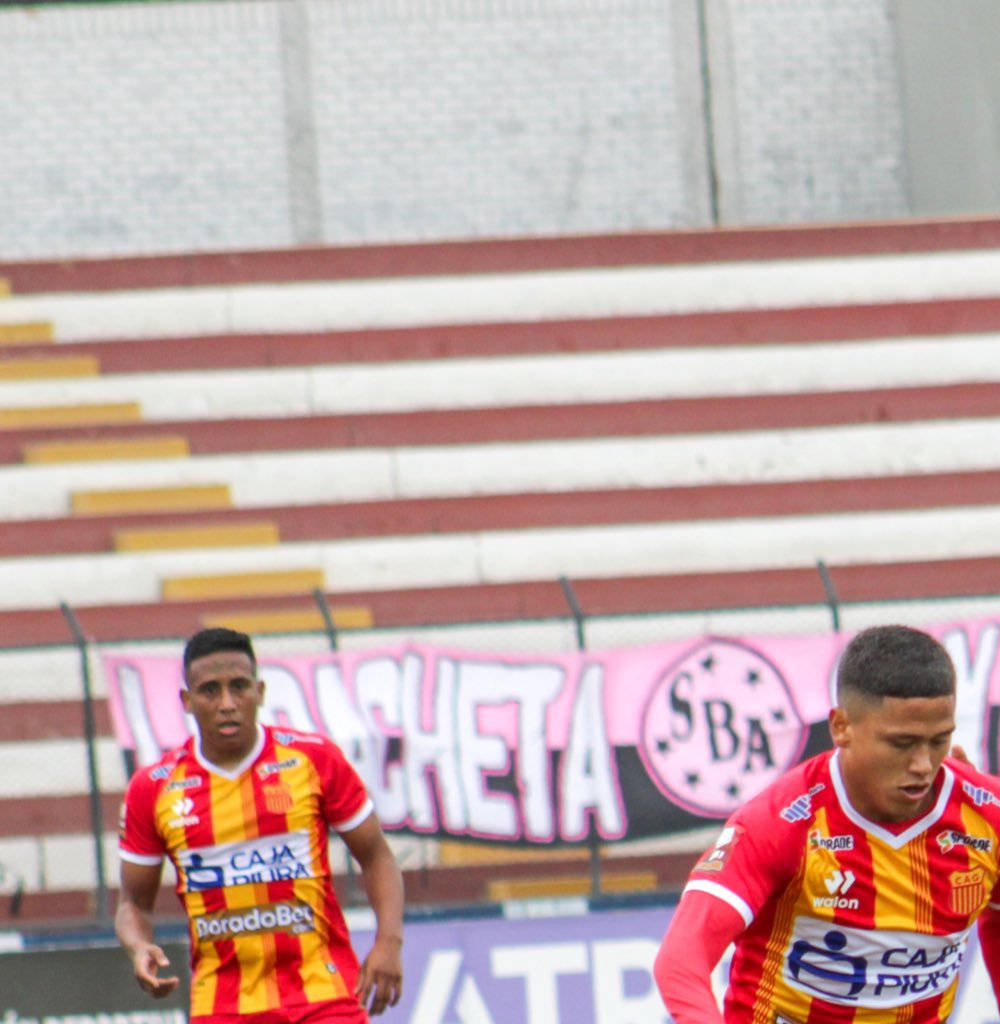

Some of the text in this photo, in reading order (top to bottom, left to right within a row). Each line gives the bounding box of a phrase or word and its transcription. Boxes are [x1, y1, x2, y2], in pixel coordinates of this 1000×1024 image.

[669, 671, 775, 774] SBA
[229, 845, 296, 872] CAJA
[953, 873, 982, 887] CAG
